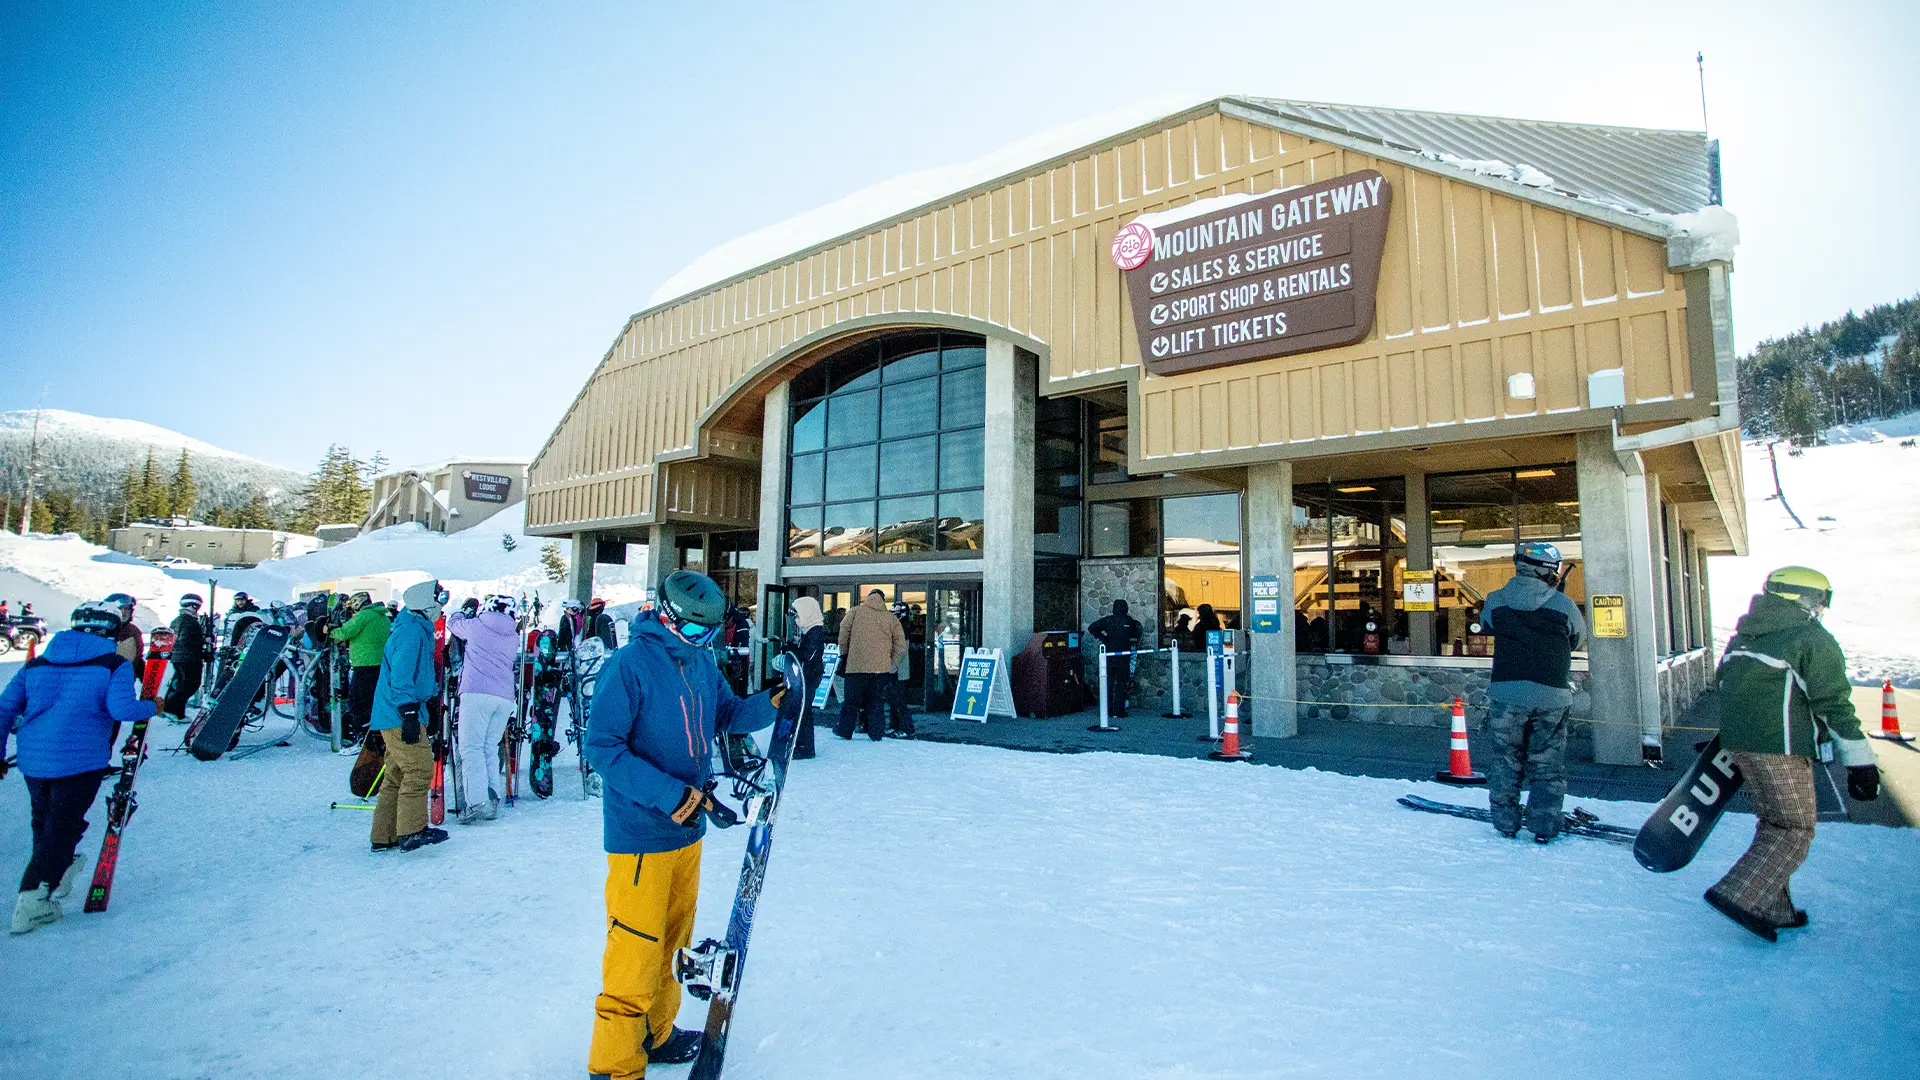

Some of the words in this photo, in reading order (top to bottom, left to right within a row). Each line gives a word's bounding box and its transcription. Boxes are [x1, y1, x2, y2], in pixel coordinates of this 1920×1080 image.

[1153, 208, 1263, 262] MOUNTAIN
[1271, 176, 1383, 231] GATEWAY
[1171, 258, 1223, 289] SALES
[1228, 254, 1240, 275] &
[1245, 233, 1323, 271] SERVICE
[1171, 292, 1216, 321] SPORT
[1220, 283, 1258, 311] SHOP
[1264, 279, 1275, 301] &
[1278, 263, 1351, 299] RENTALS
[1171, 328, 1205, 355] LIFT
[1212, 312, 1287, 346] TICKETS
[472, 474, 487, 482] WEST
[487, 476, 509, 485] VILLAGE
[479, 483, 497, 492] LODGE
[1253, 588, 1268, 596] PICK
[1268, 588, 1278, 596] UP
[662, 600, 677, 621] SMITH
[966, 667, 981, 676] PICK
[981, 668, 989, 677] UP
